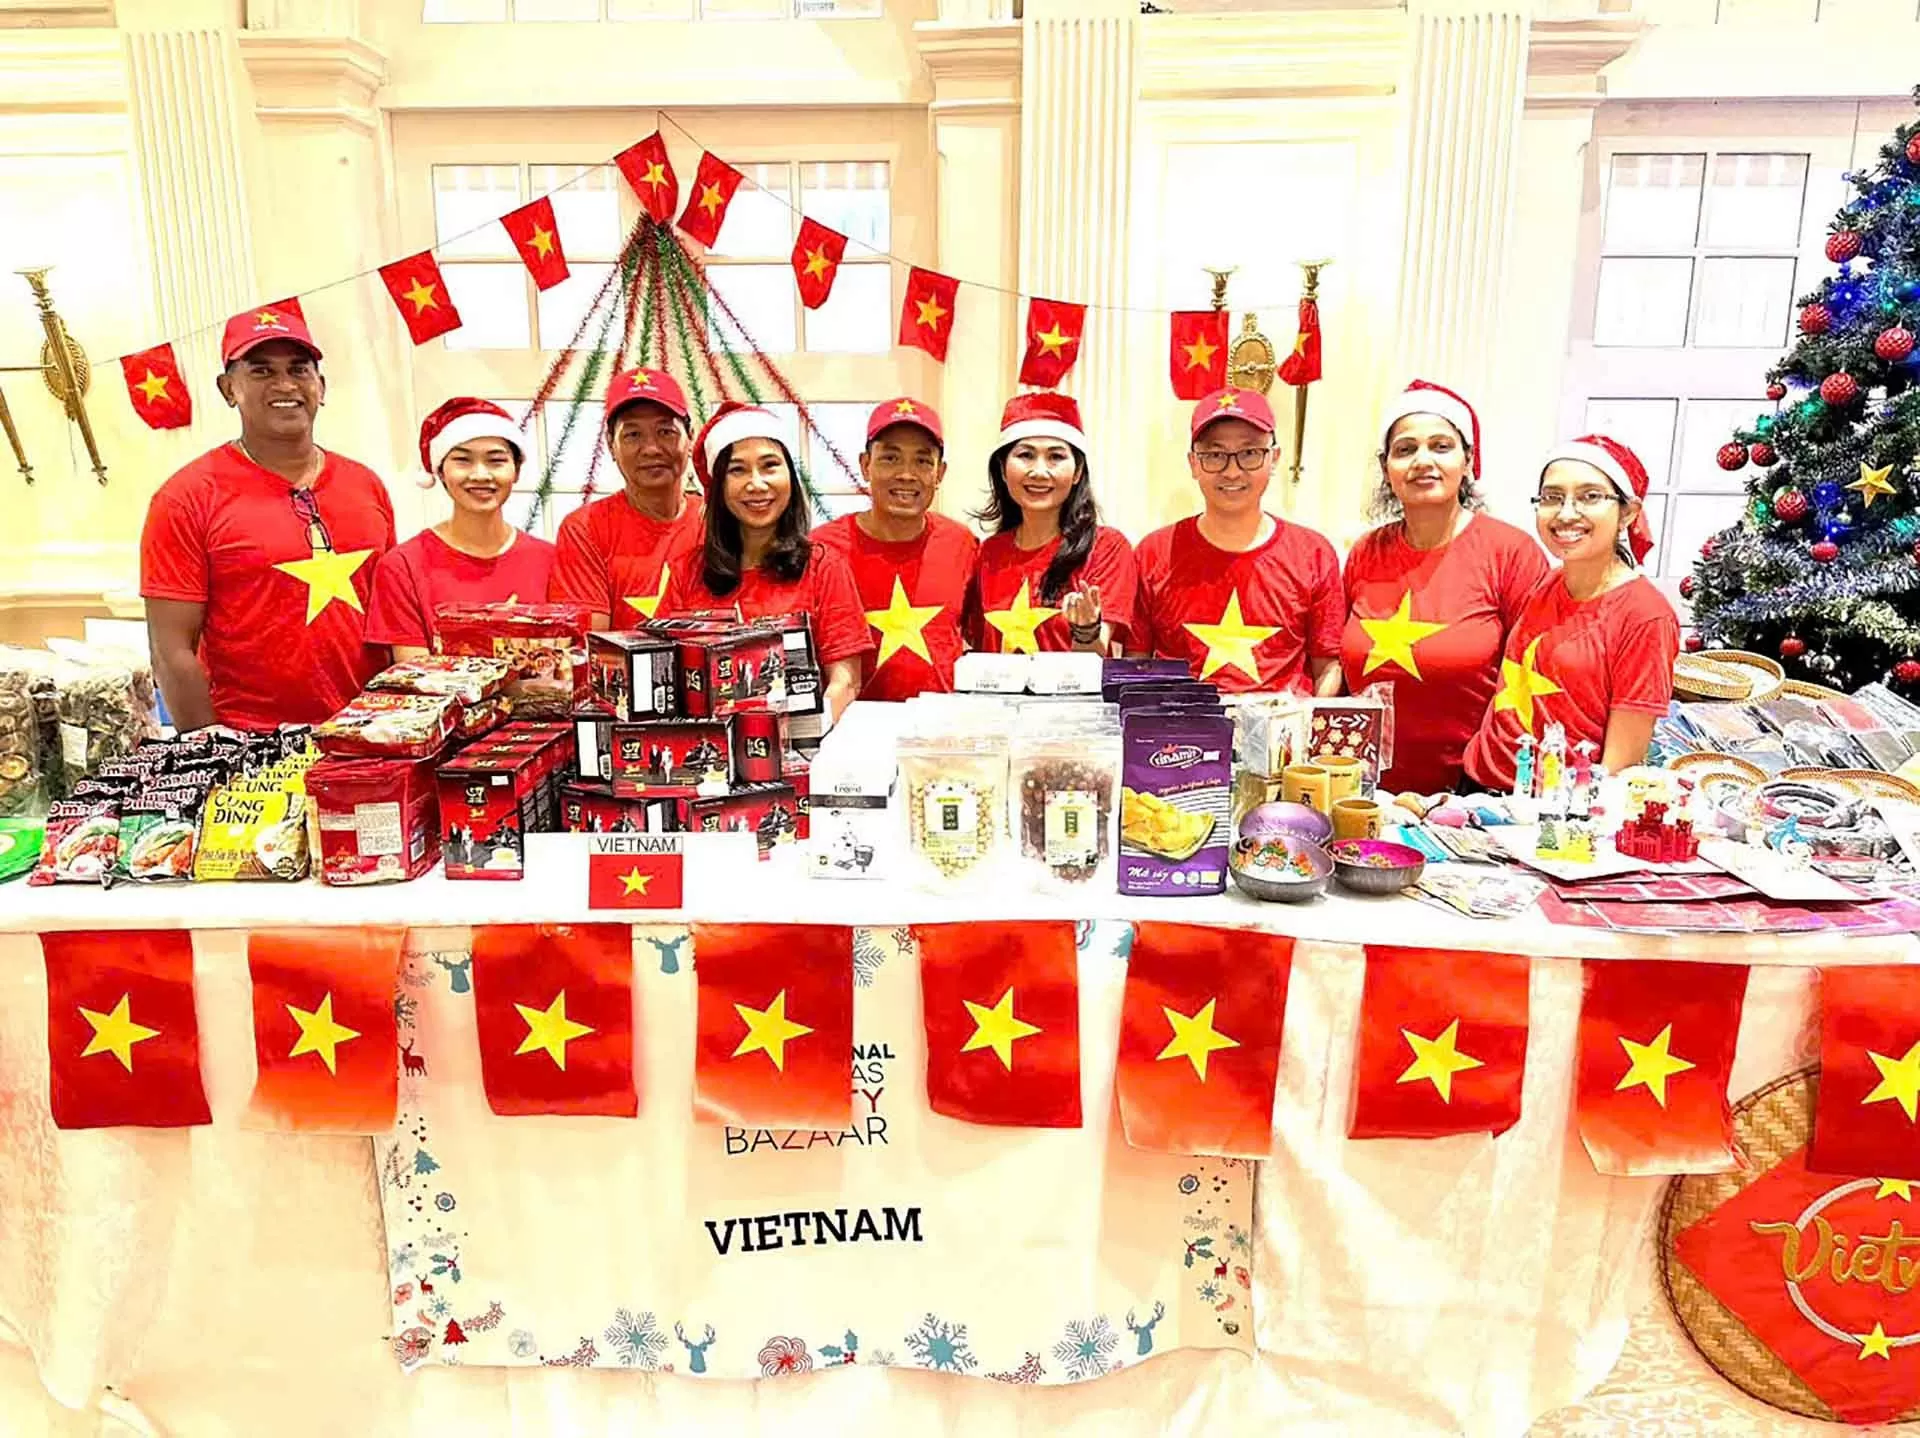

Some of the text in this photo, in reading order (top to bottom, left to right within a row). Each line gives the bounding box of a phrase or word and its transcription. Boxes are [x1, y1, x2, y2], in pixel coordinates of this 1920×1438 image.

[598, 838, 676, 853] VIETNAM
[724, 1116, 889, 1155] BAZAAR
[704, 1207, 924, 1256] VIETNAM
